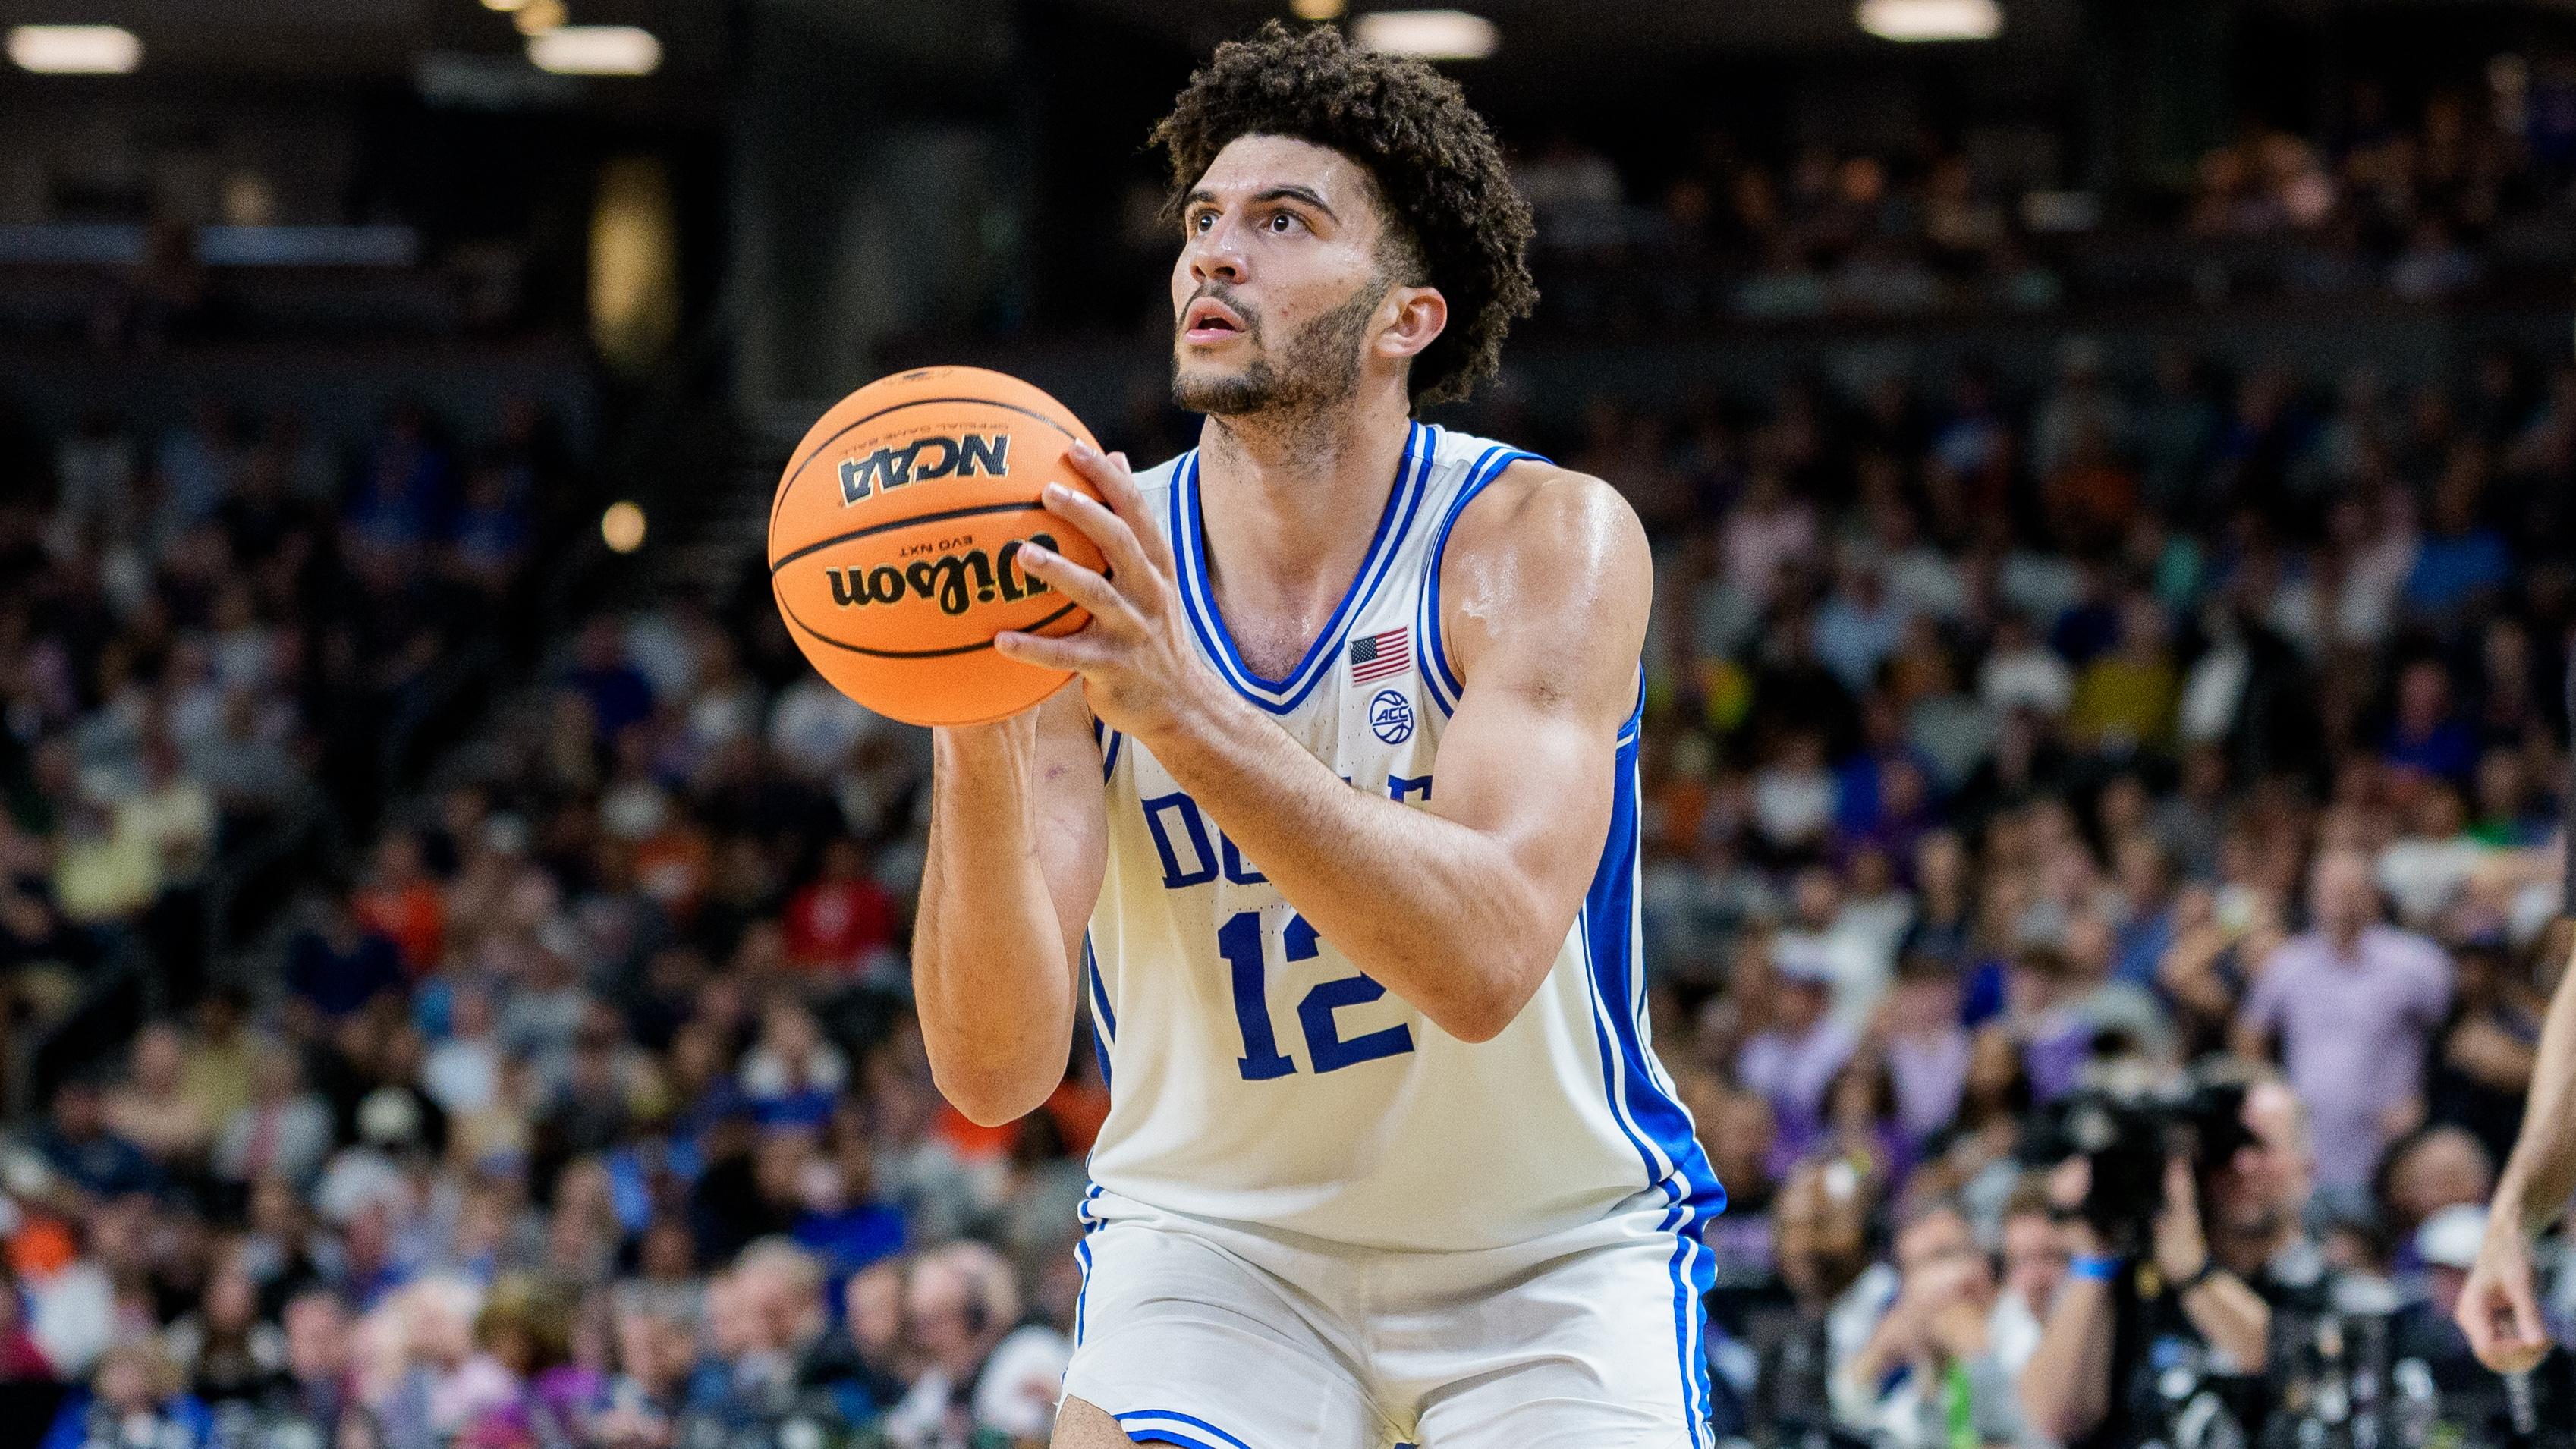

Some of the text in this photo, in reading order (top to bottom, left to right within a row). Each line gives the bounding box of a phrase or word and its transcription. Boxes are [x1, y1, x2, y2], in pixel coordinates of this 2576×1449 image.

[838, 435, 1009, 506] NCAA
[899, 535, 973, 557] EVO NXT
[1376, 705, 1409, 721] ACC
[1217, 911, 1415, 1080] 12
